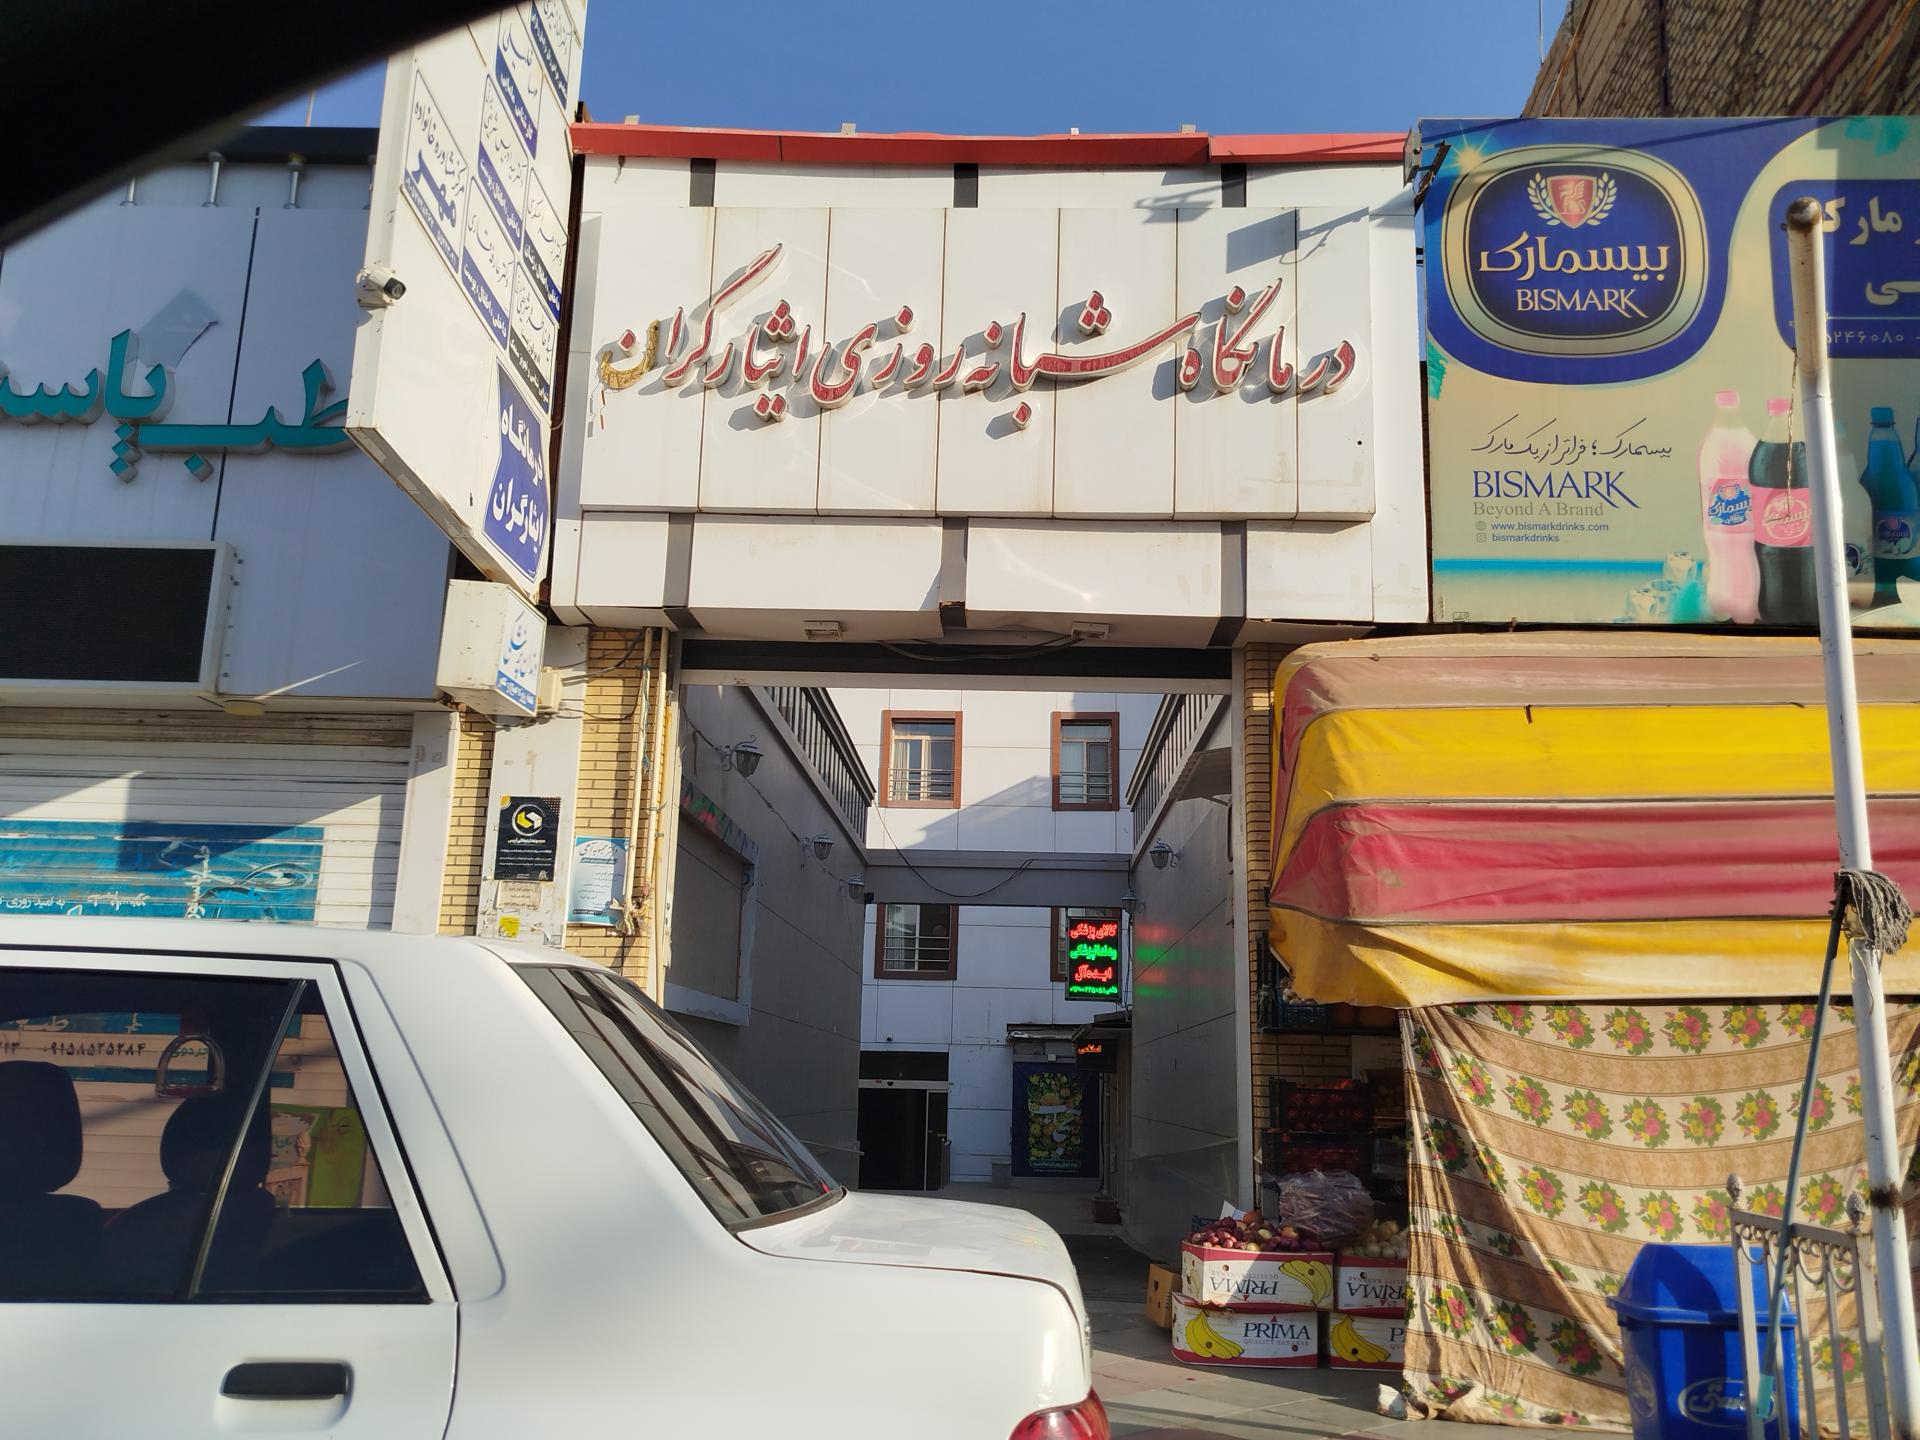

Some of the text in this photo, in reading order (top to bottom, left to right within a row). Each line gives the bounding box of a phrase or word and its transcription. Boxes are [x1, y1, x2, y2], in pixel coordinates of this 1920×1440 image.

[414, 101, 437, 145] خانواده
[434, 140, 456, 176] مشاوره
[1478, 231, 1670, 282] بیسمارک
[1516, 288, 1649, 319] BISMARK
[601, 244, 1356, 430] درمانگاه شبانه روزی ایثارگران
[501, 403, 543, 486] درمانگاه
[1471, 413, 1519, 454] مارک
[1504, 418, 1557, 459] یک
[1537, 434, 1559, 464] از
[1550, 434, 1587, 466] فراتر
[1473, 470, 1641, 509] BISMARK
[492, 478, 544, 553] ایثارگران
[1474, 501, 1604, 519] Beyond A Brand
[1491, 521, 1609, 532] www.bismarkdrinks.com
[1492, 532, 1560, 542] bismarkdrinks
[1070, 923, 1096, 940] پزشکی
[1210, 1276, 1279, 1296] PRIMA
[1243, 1321, 1312, 1341] PRIMA
